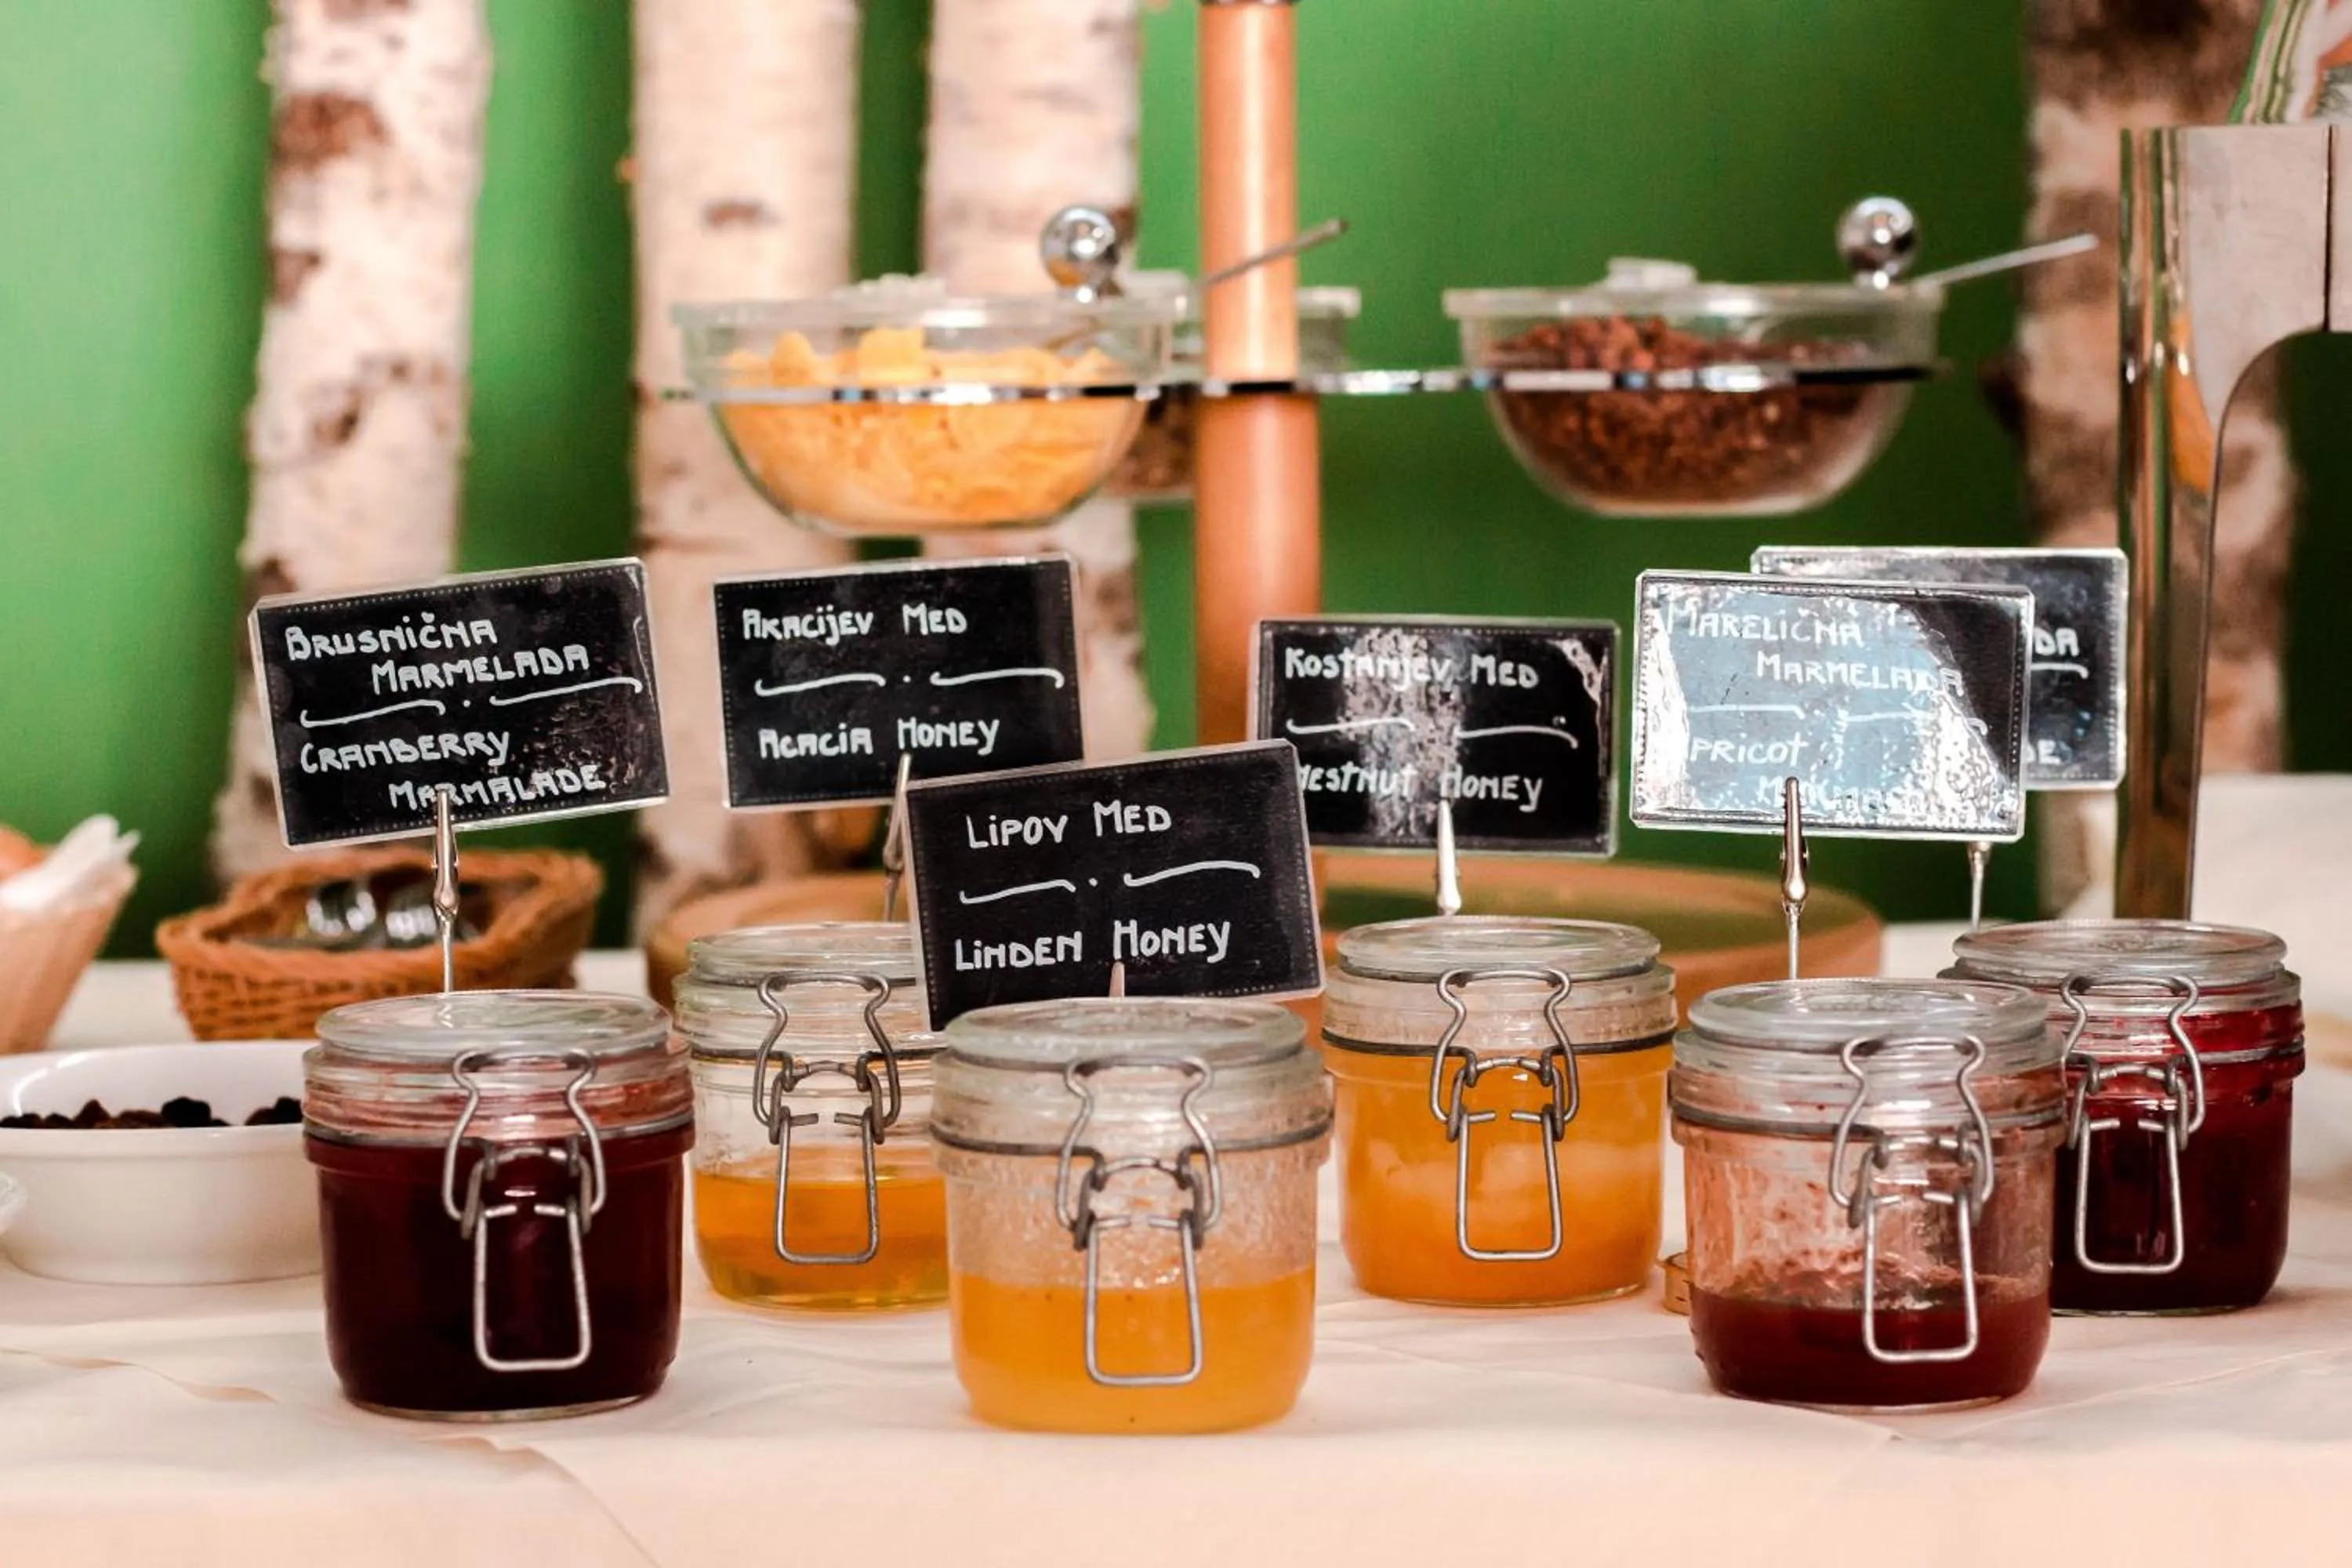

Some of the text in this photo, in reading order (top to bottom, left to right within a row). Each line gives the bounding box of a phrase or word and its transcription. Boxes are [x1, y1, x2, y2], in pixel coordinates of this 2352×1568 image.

[902, 601, 967, 635] MED
[372, 643, 591, 696] MARMELADA
[1471, 655, 1540, 690] MED
[300, 730, 510, 775] CRANBERRY
[1689, 730, 1809, 767] PRiCOT
[388, 764, 607, 811] MARMALADE
[1092, 800, 1172, 837] MED
